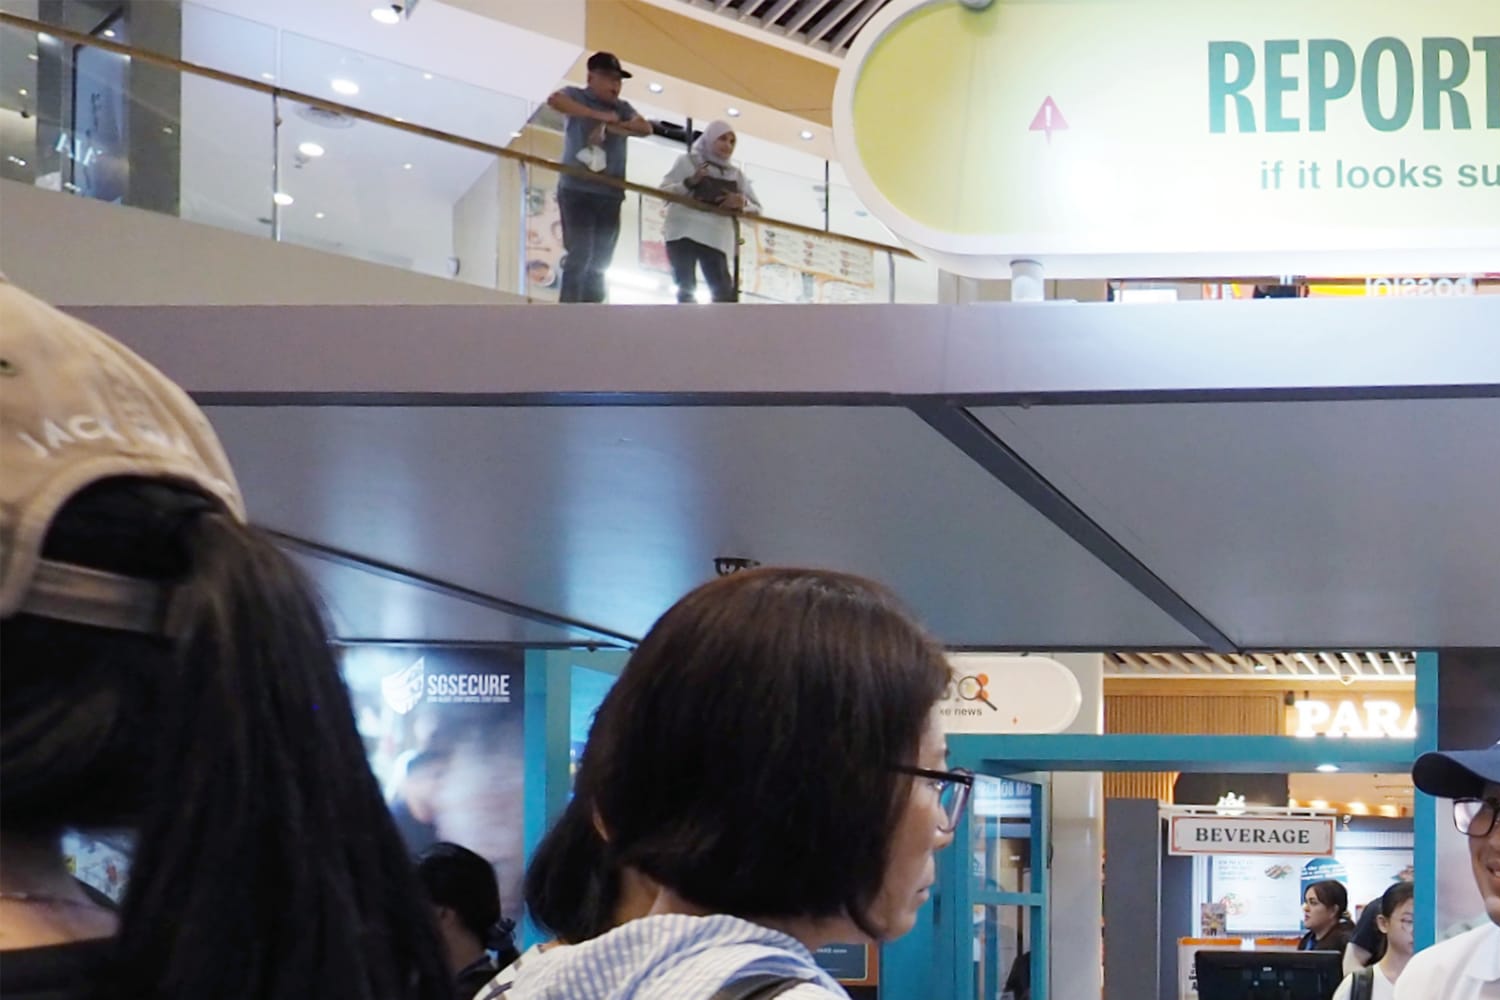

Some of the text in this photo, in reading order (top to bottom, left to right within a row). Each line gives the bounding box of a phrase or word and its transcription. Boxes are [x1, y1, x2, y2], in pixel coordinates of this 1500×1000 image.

[1260, 159, 1284, 189] if
[1298, 158, 1320, 189] it
[1336, 158, 1443, 189] looks
[427, 674, 510, 696] SGSECURE
[954, 707, 983, 716] news
[1195, 827, 1310, 845] BEVERAGE
